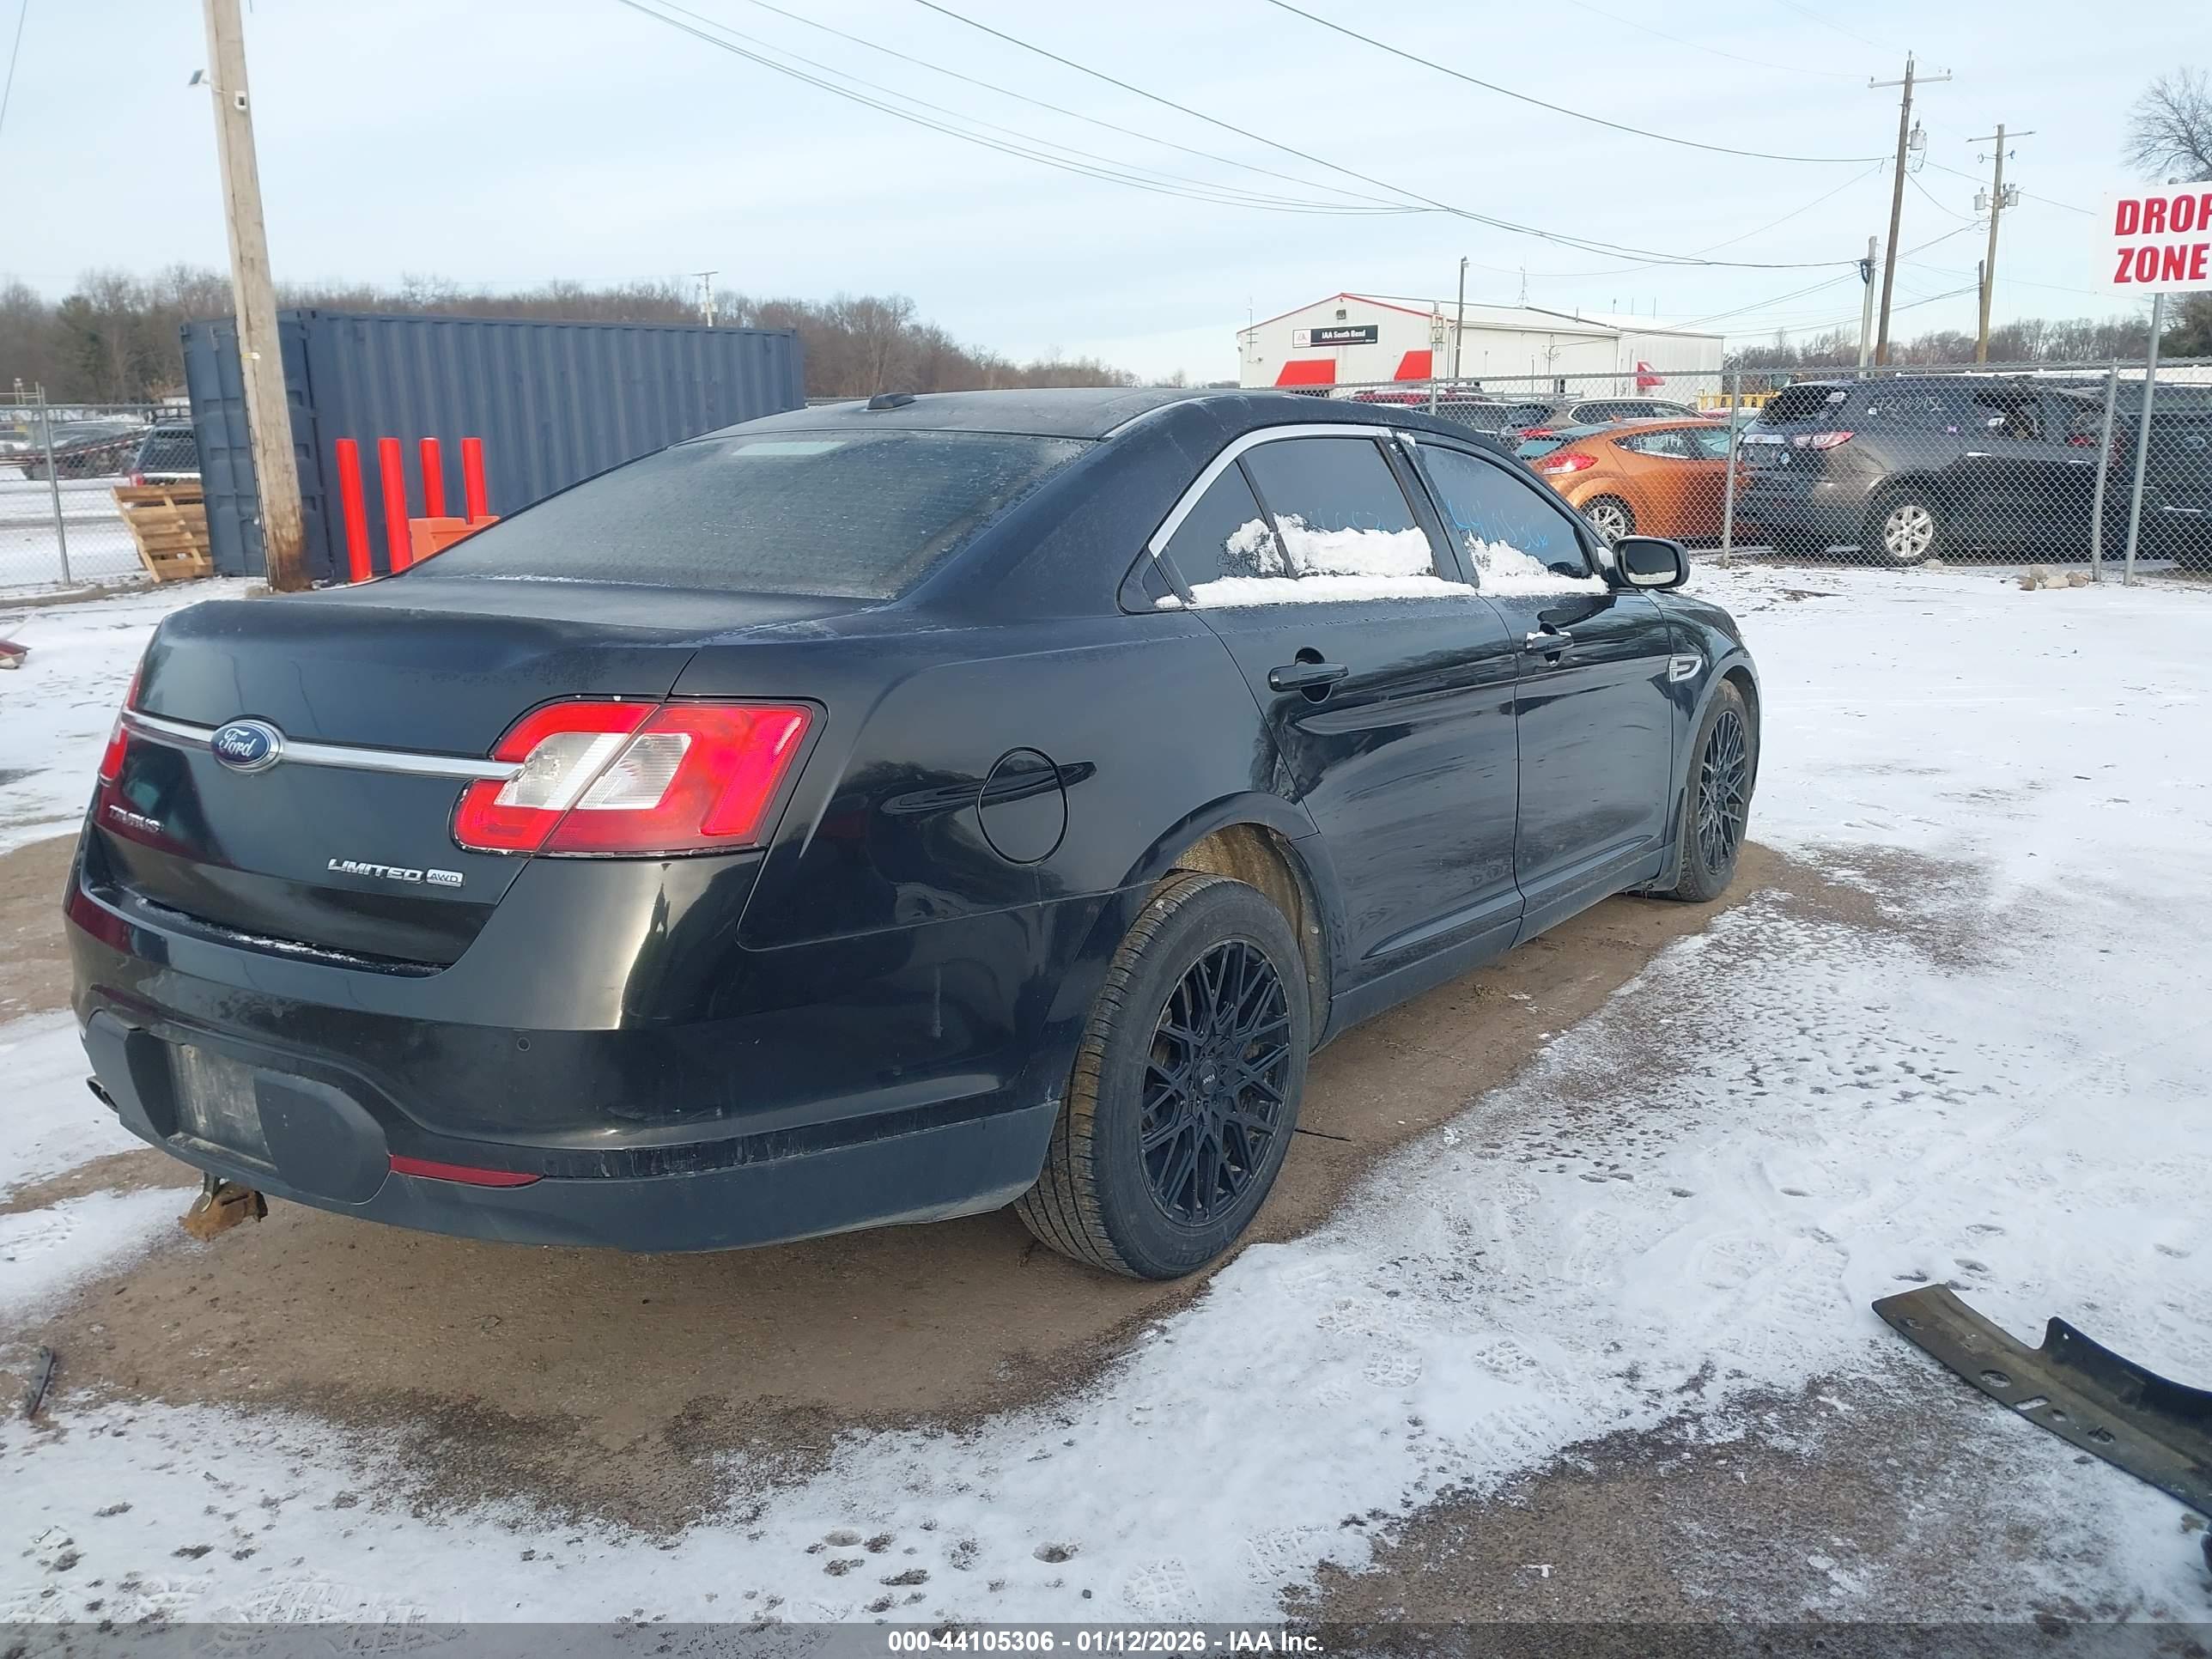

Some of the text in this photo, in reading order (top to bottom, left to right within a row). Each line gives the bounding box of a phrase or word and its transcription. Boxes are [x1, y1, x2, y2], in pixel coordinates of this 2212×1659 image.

[2113, 242, 2210, 283] ZONE
[1334, 330, 1351, 338] South
[1351, 329, 1365, 337] Bend
[218, 727, 257, 757] Ford
[327, 858, 461, 885] LIMITED AWD
